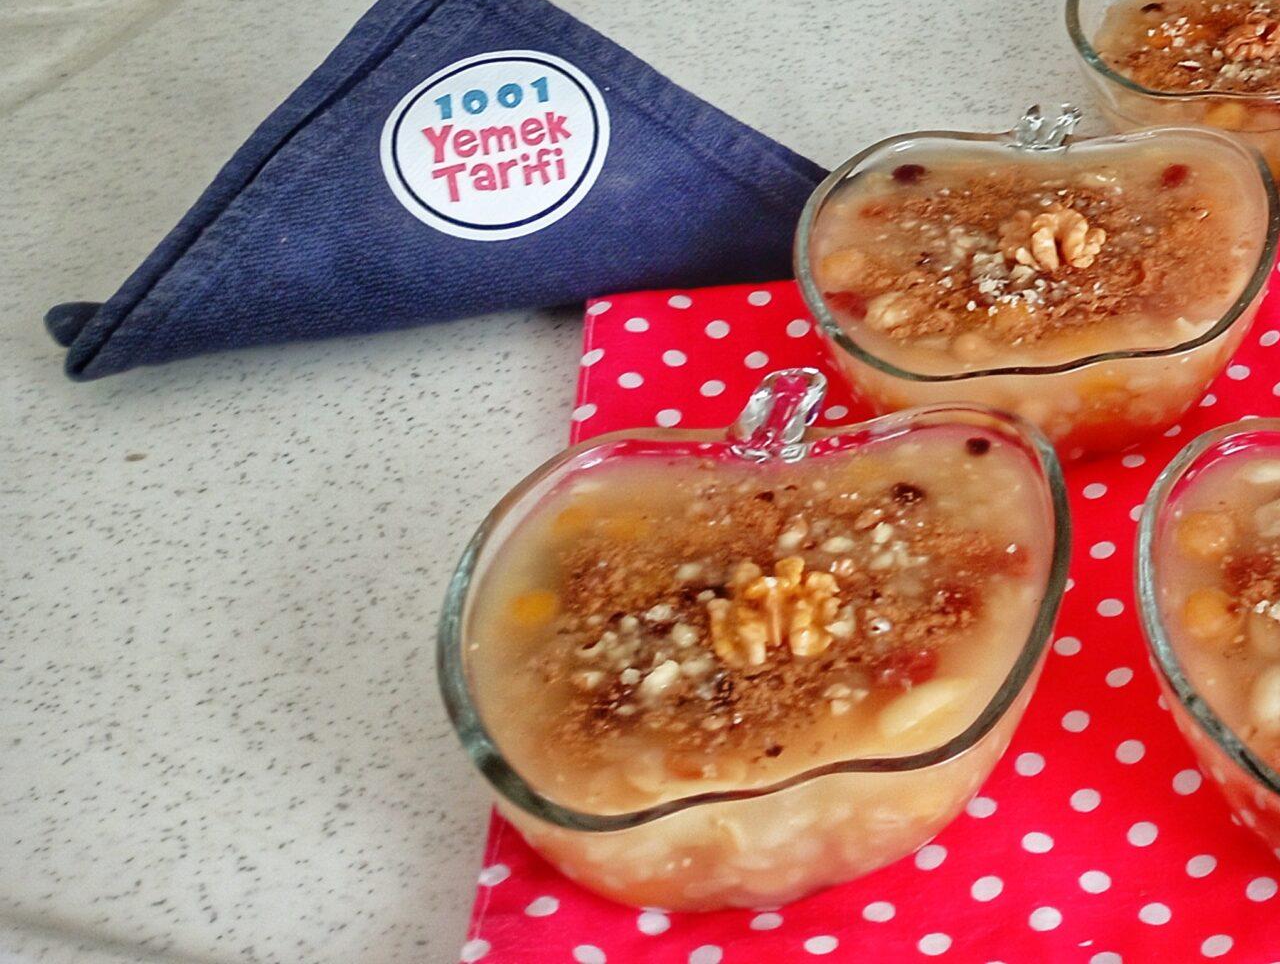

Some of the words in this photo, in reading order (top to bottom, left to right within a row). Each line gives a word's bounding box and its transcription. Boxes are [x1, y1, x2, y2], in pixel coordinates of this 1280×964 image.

[434, 76, 549, 120] 1001
[422, 112, 572, 163] Yemek
[431, 148, 566, 202] Tarifi
